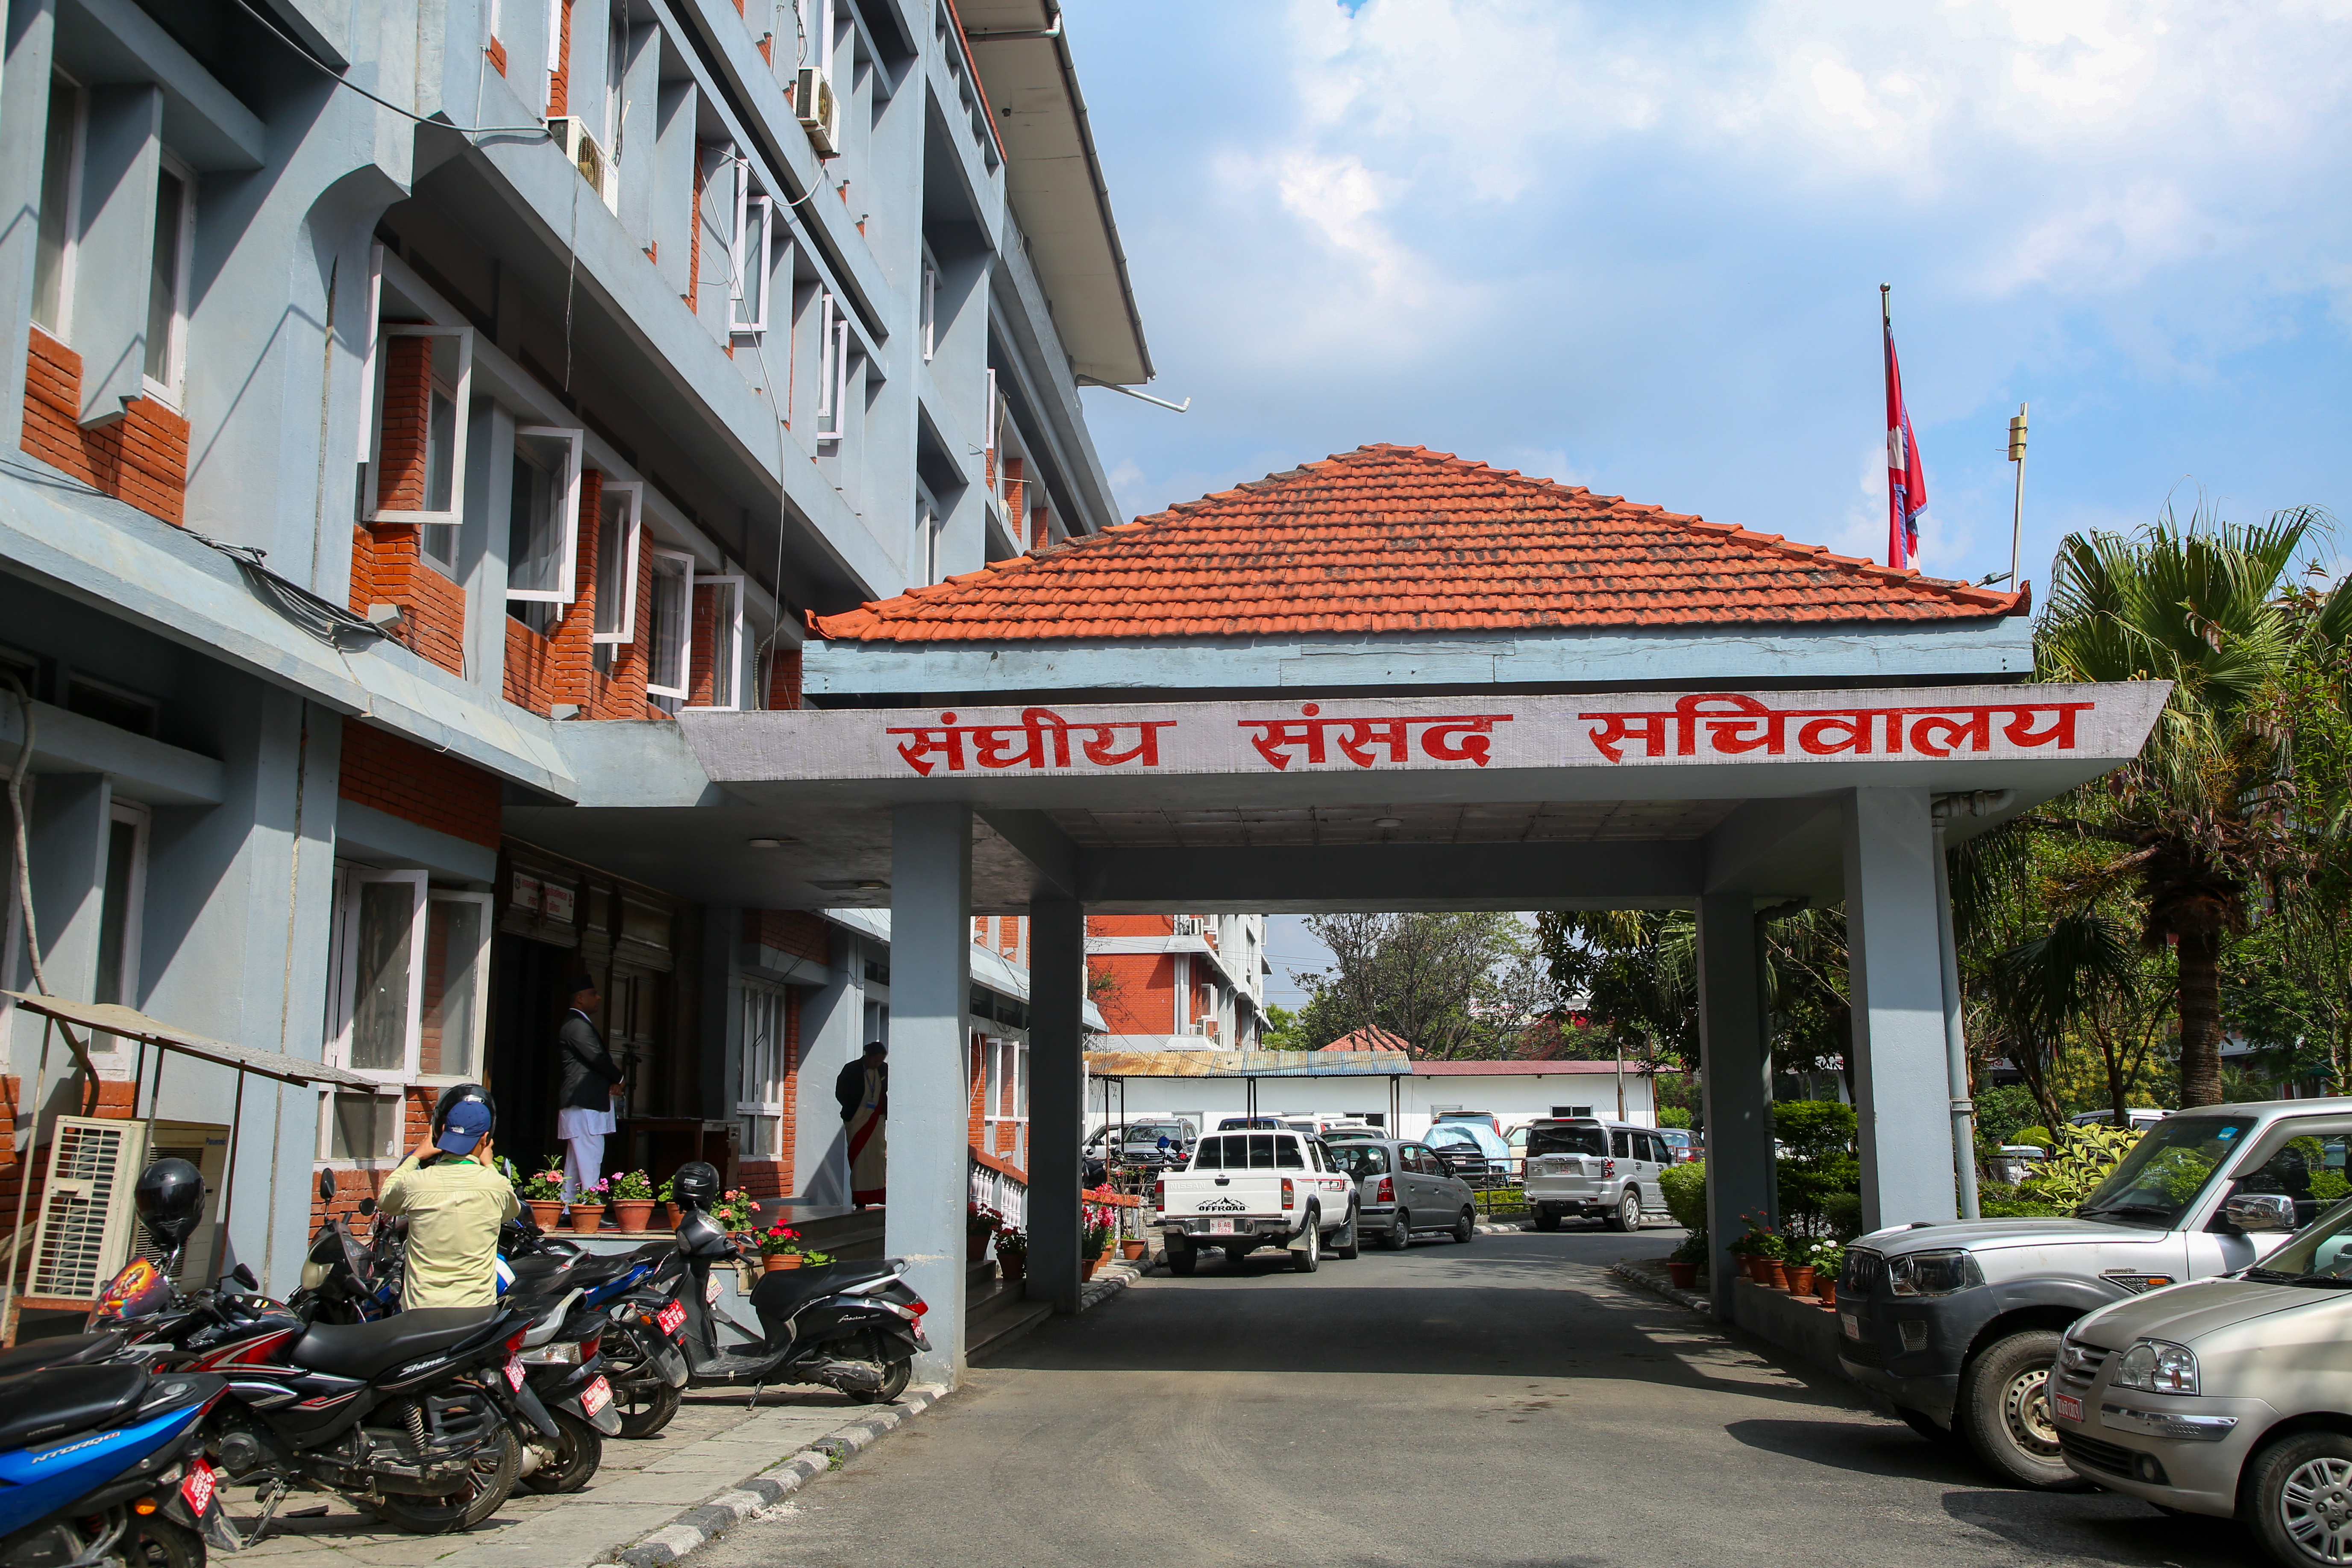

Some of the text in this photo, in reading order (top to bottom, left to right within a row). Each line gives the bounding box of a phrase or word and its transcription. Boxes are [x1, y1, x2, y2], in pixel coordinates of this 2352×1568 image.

[887, 693, 2094, 776] संघीय संसद सचिवालय
[397, 1356, 448, 1377] Shine
[31, 1436, 103, 1464] NTORQ
